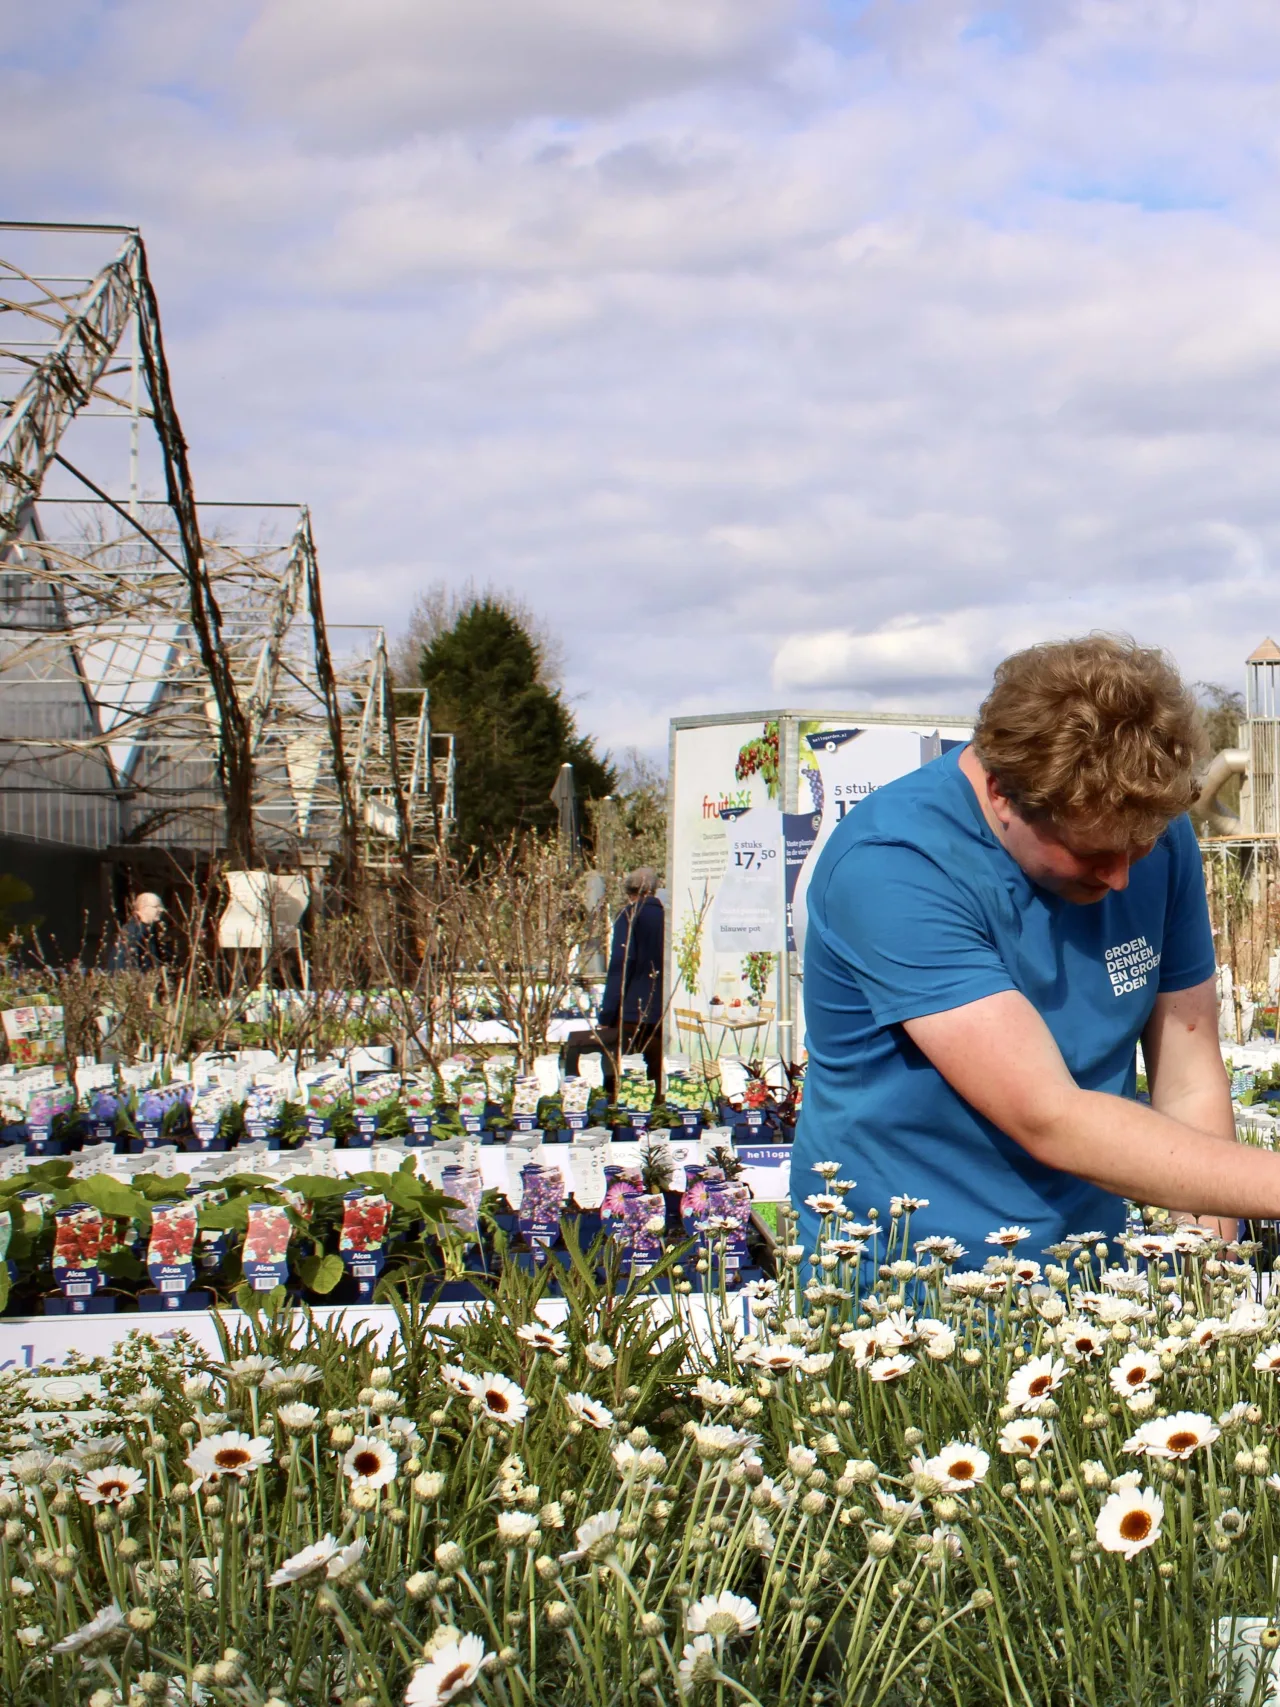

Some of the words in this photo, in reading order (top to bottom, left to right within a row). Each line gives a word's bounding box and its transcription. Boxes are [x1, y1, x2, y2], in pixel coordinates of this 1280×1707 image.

[834, 786, 842, 796] 5
[734, 849, 776, 870] 17,50
[1104, 936, 1147, 961] GROEN
[1106, 946, 1154, 973] DENKEN
[1109, 970, 1128, 985] EN
[1113, 975, 1147, 997] DOEN
[747, 1151, 793, 1159] helloga
